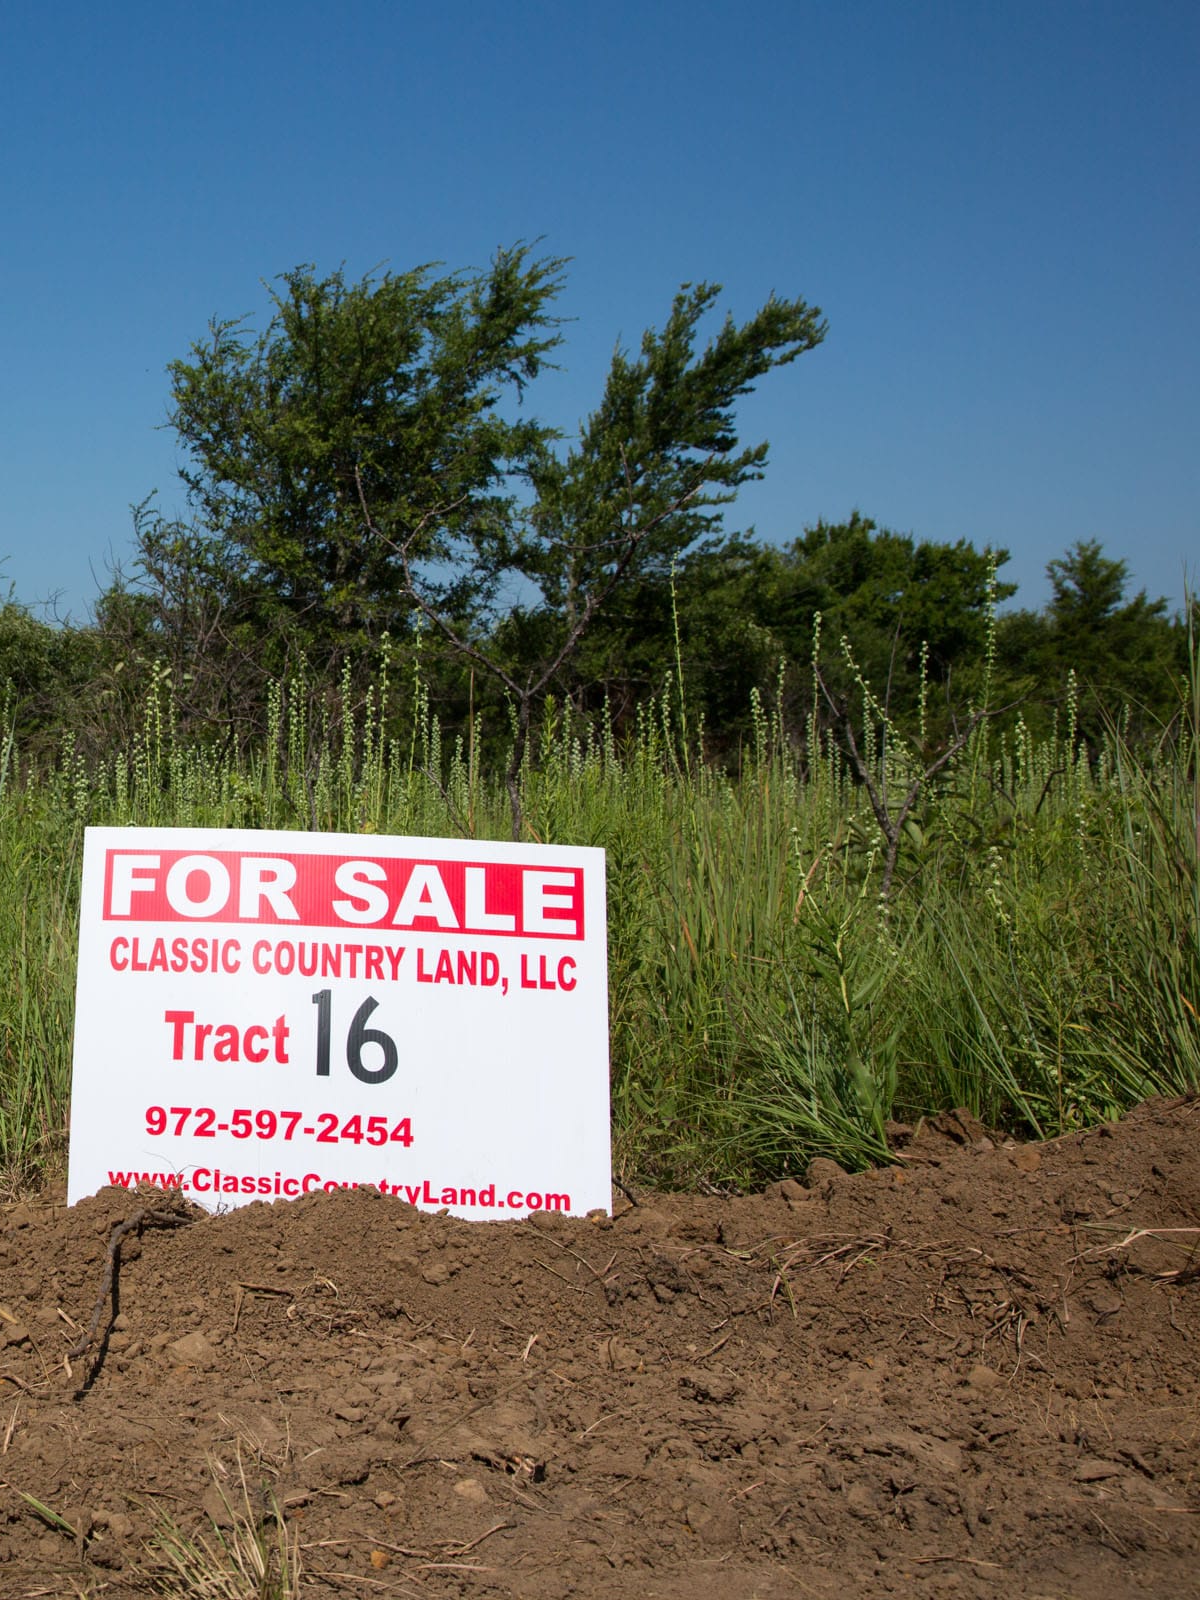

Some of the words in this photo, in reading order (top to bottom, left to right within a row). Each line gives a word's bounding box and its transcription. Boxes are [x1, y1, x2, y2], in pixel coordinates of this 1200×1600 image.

[109, 854, 301, 921] FOR
[332, 860, 578, 935] SALE
[109, 936, 241, 974] CLASSIC
[252, 940, 405, 981] COUNTRY
[416, 947, 509, 996] LAND,
[520, 953, 578, 992] LLC
[164, 1010, 290, 1065] Tract
[311, 989, 399, 1085] 16
[145, 1106, 415, 1148] 972-597-2454
[108, 1168, 571, 1212] www.ClassicCotryLand.com
